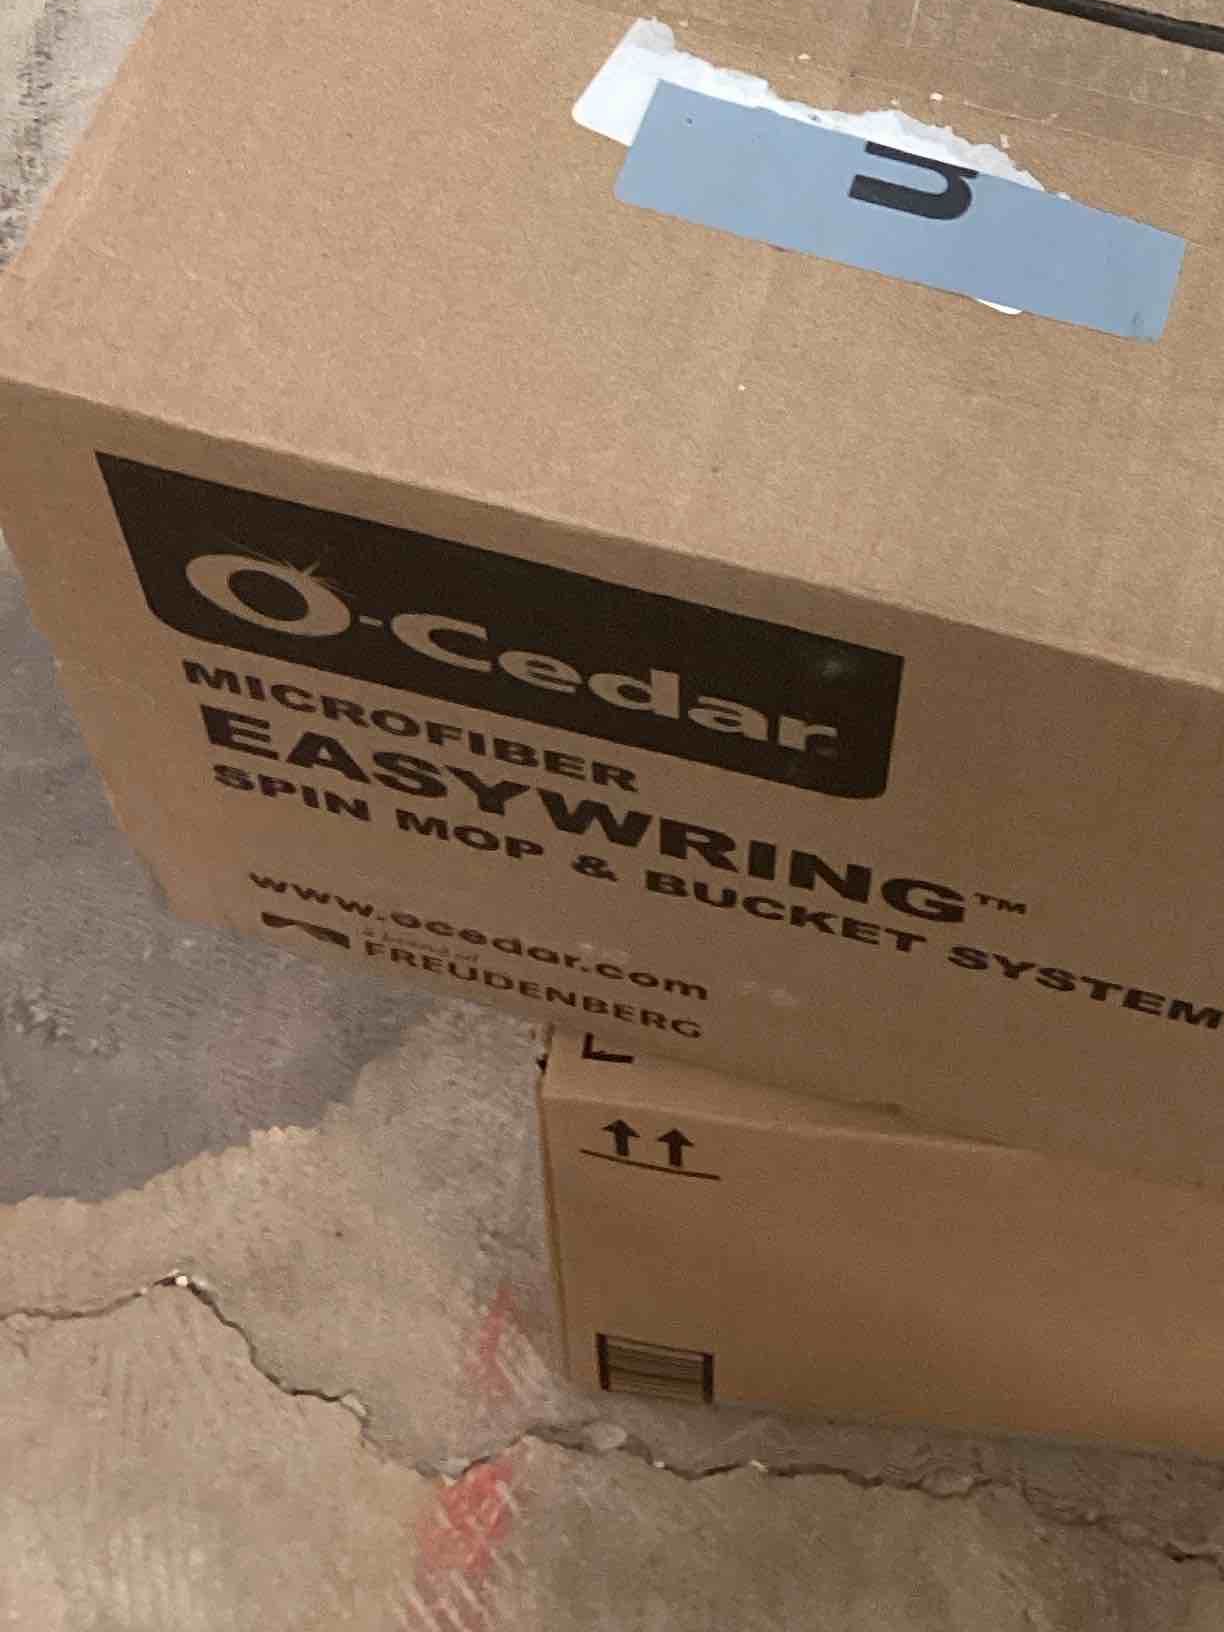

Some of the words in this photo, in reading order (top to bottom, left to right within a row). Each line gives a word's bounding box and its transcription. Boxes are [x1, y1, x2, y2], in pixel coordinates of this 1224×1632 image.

[185, 551, 839, 752] O-Cedar
[182, 659, 639, 793] MICROFIBER
[211, 764, 372, 822] SPIN
[395, 808, 545, 860] MOP
[570, 854, 618, 883] &
[645, 869, 927, 954] BUCKET
[946, 945, 1224, 1030] SYSTEM
[248, 871, 709, 1002] www.ocedar.com
[363, 940, 704, 1039] FREUDENBERG
